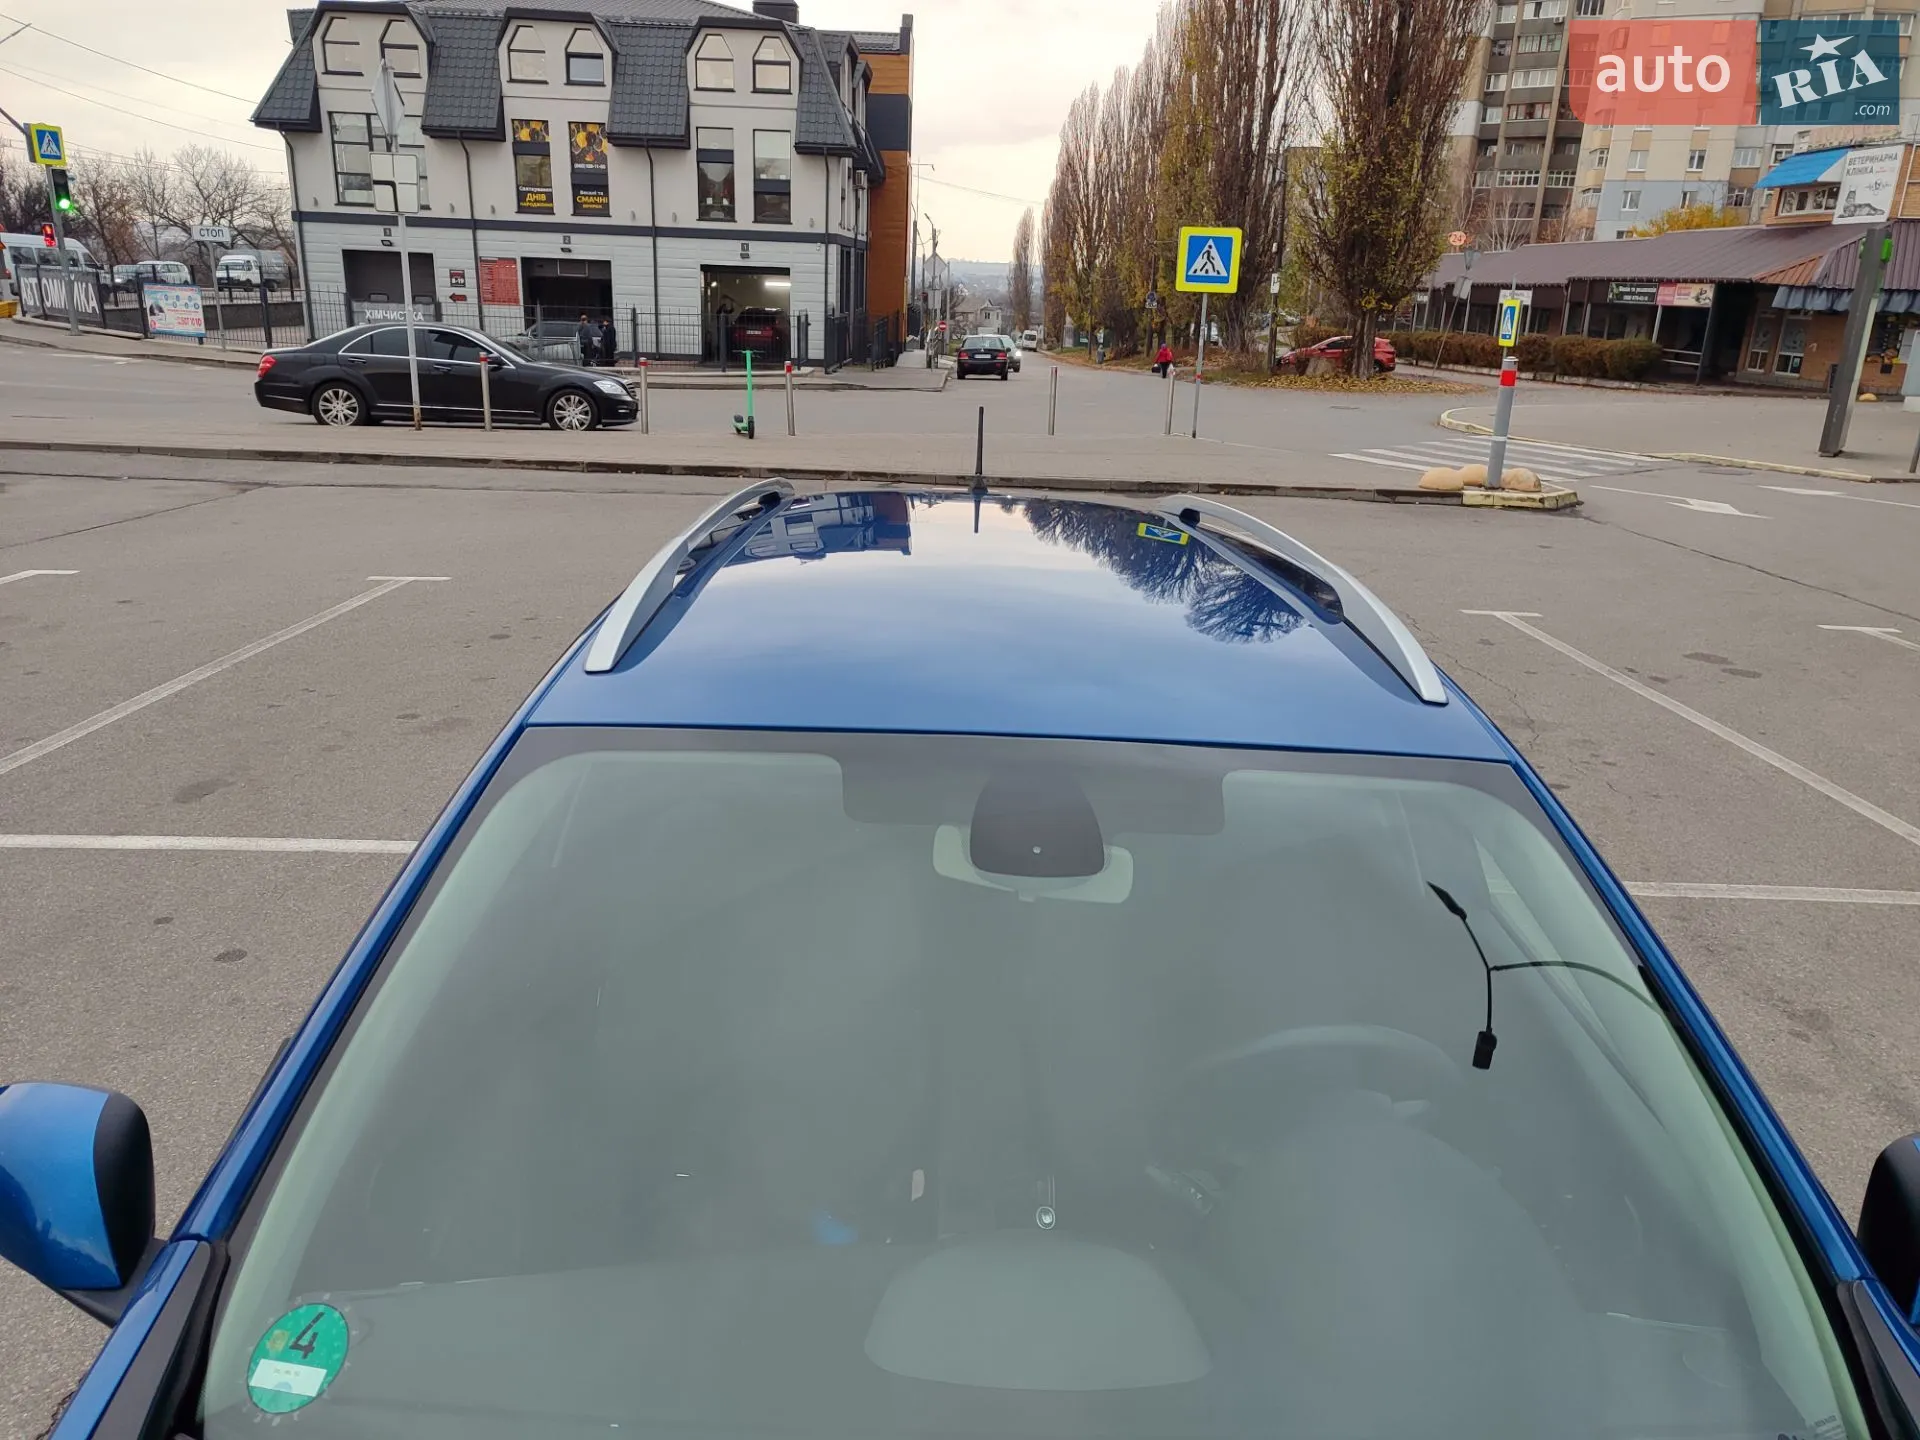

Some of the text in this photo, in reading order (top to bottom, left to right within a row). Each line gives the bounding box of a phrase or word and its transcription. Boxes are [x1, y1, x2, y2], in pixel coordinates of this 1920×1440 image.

[1847, 153, 1898, 166] ВЕТЕРИНАРНА
[1846, 166, 1874, 177] КЛІНІКА
[526, 193, 547, 202] ДНІВ
[576, 196, 608, 204] СМАЧНІ
[199, 228, 224, 238] СТОП
[288, 1311, 326, 1360] 4
